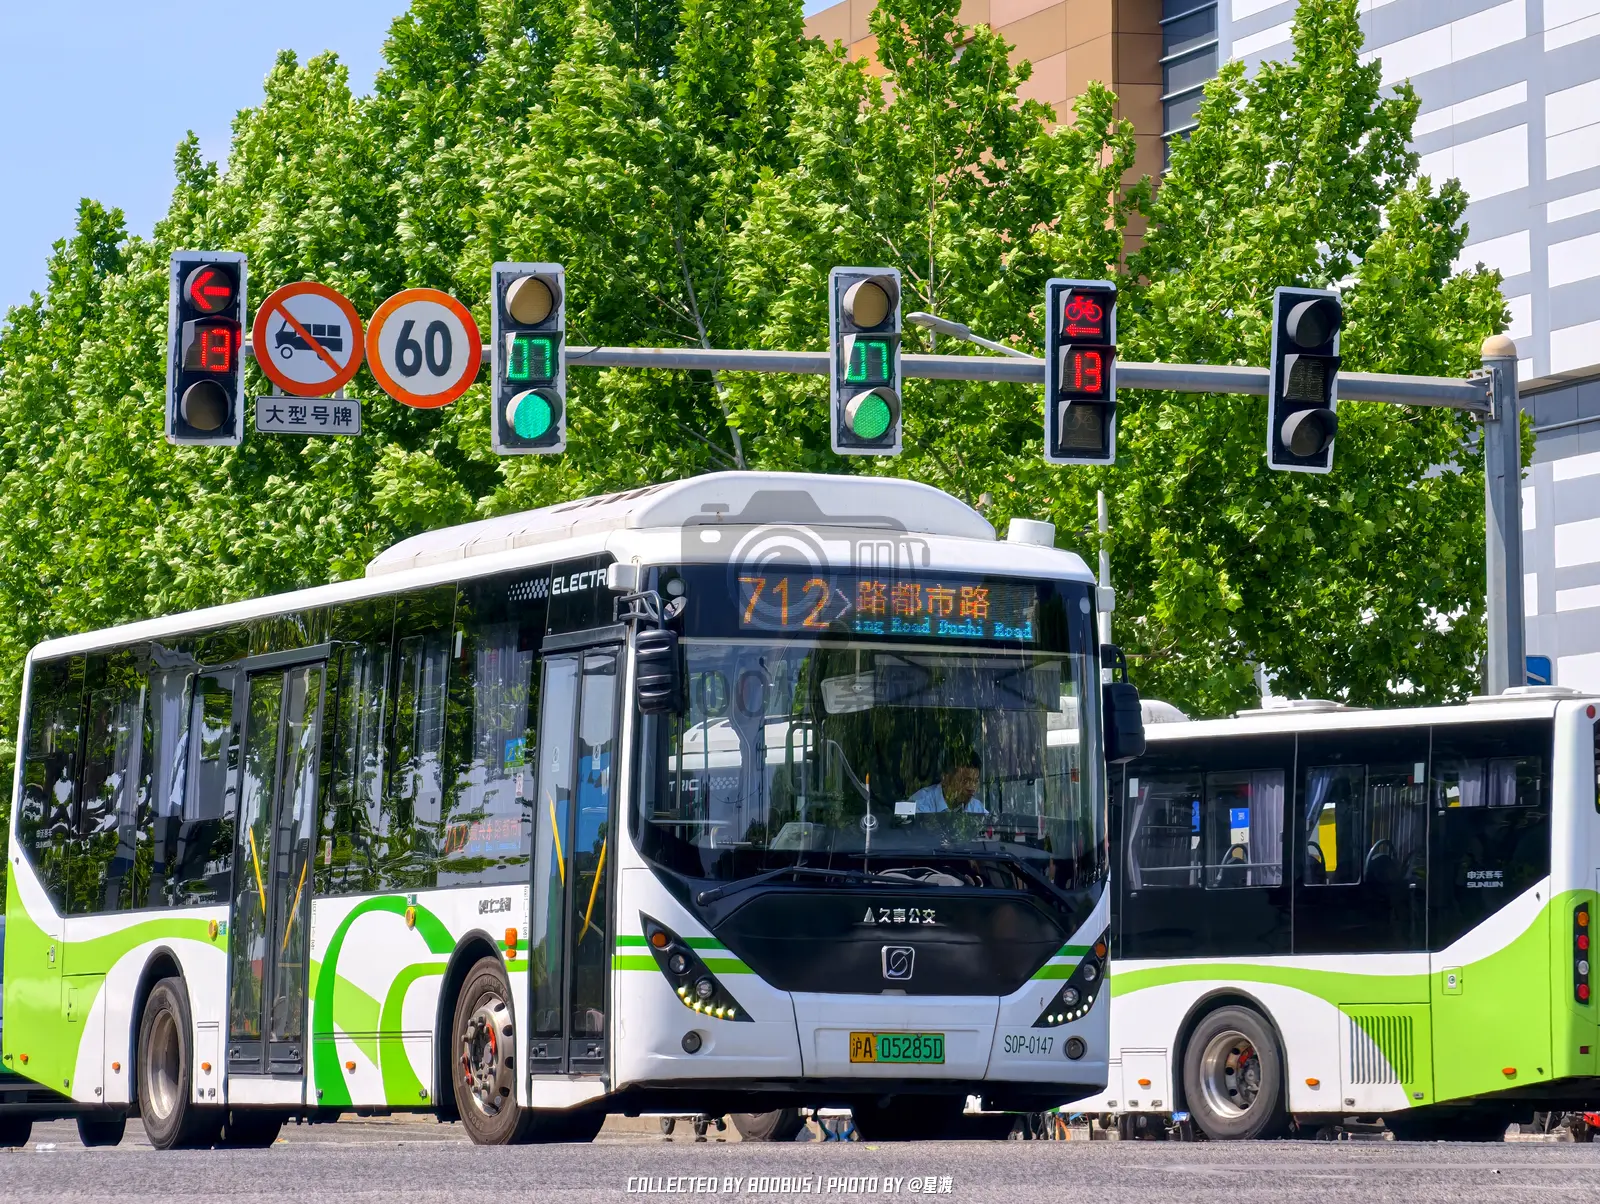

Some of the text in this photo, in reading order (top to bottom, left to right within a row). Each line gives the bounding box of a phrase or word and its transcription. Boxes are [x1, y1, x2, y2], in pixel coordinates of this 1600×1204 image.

[201, 327, 231, 373] 13
[394, 319, 453, 378] 60
[1075, 351, 1103, 393] 13
[265, 404, 353, 427] 大型号牌
[738, 577, 990, 627] 712 路都市路
[892, 617, 931, 634] Road
[939, 619, 984, 637] Dushi
[994, 622, 1033, 639] Road
[1467, 871, 1503, 879] 申沃客车
[878, 907, 936, 924] 久事公交
[852, 1037, 943, 1059] 沪A 05285D
